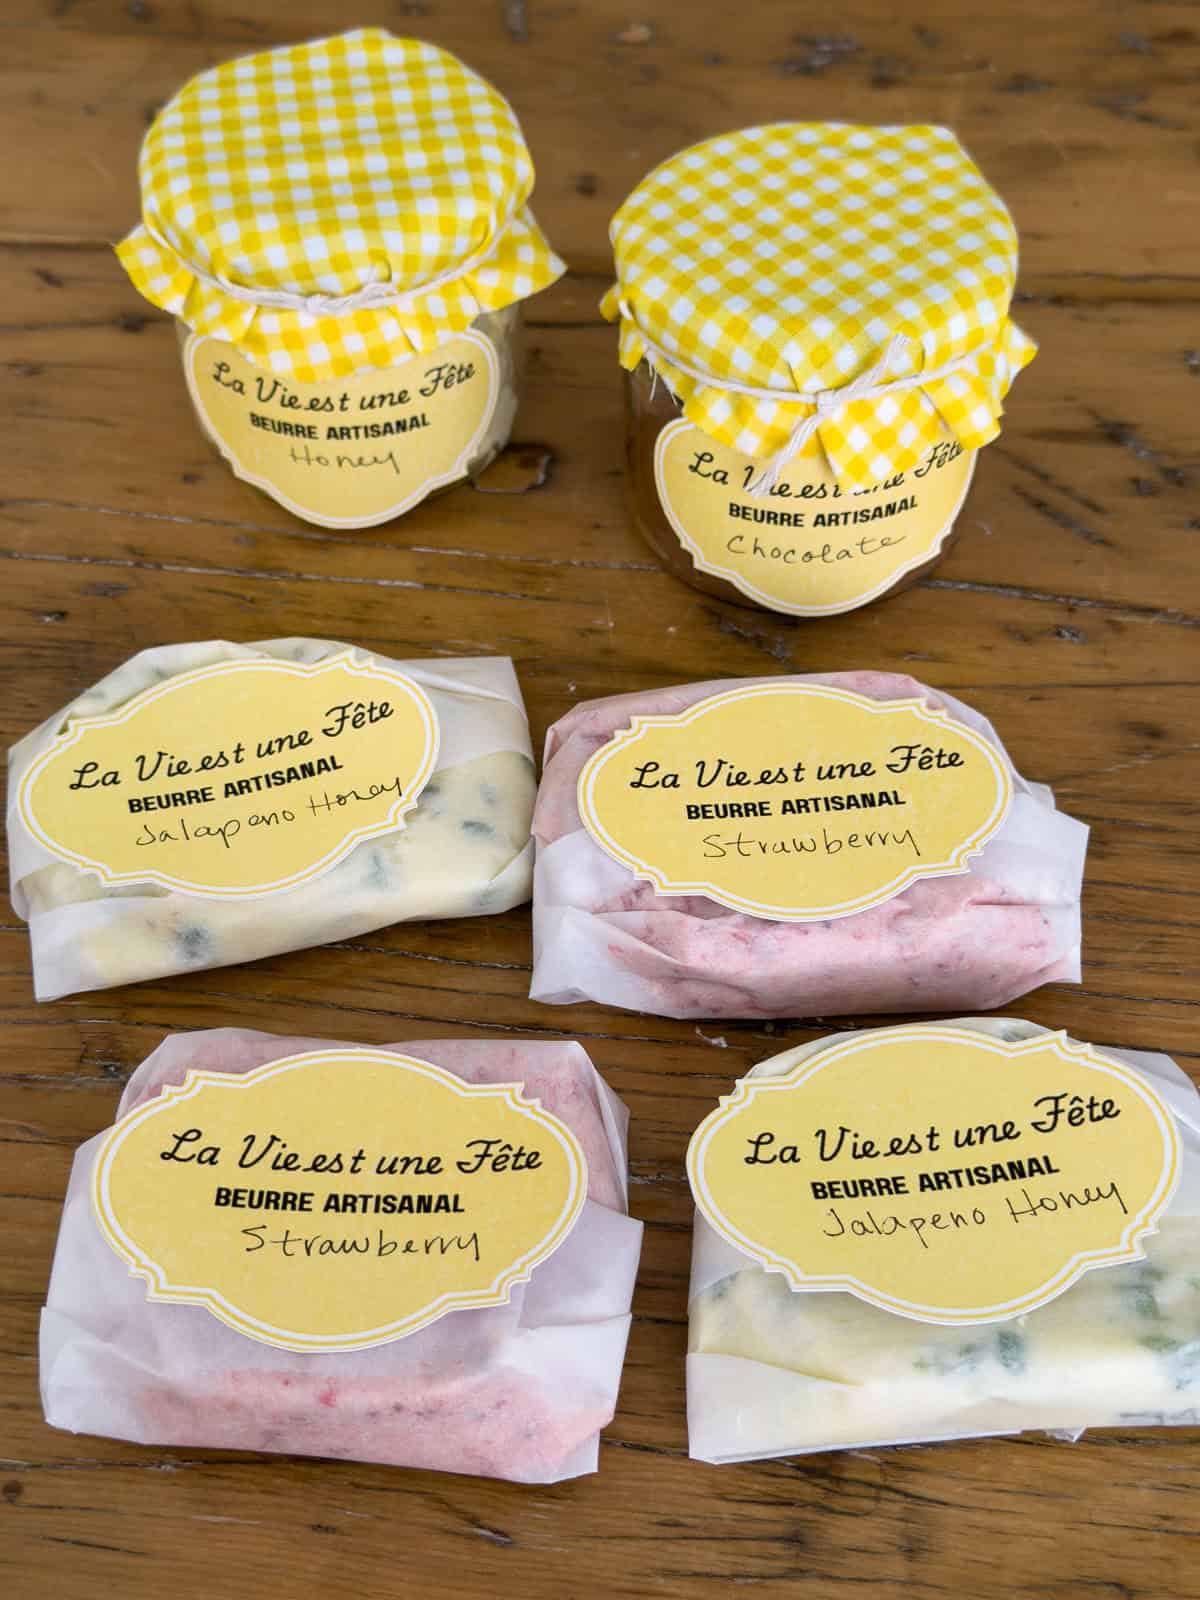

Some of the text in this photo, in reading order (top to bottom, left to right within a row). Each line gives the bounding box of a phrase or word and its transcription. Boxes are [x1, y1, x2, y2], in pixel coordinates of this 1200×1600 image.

[213, 362, 475, 412] La Vie est une Fête
[250, 412, 430, 440] BEURRE ARTISANAL
[290, 446, 400, 474] Honey
[688, 452, 728, 485] La
[729, 495, 918, 527] BEURRE ARTISANAL
[727, 535, 906, 563] Chocolate
[69, 701, 394, 790] La Vie est une Fête
[128, 755, 344, 813] BEURRE ARTISANAL
[630, 744, 964, 788] La Vie est une Fête
[306, 777, 402, 816] Honey
[686, 790, 906, 820] BEURRE ARTISANAL
[702, 828, 920, 857] Strawberry
[744, 1093, 1121, 1164] La Vie est une Fête
[160, 1129, 543, 1175] La Vie est une Fête
[810, 1155, 1060, 1200] BEURRE ARTISANAL
[214, 1187, 465, 1214] BEURRE ARTISANAL
[823, 1182, 1128, 1248] Jalapeno Honey
[240, 1224, 480, 1262] Strawberry
